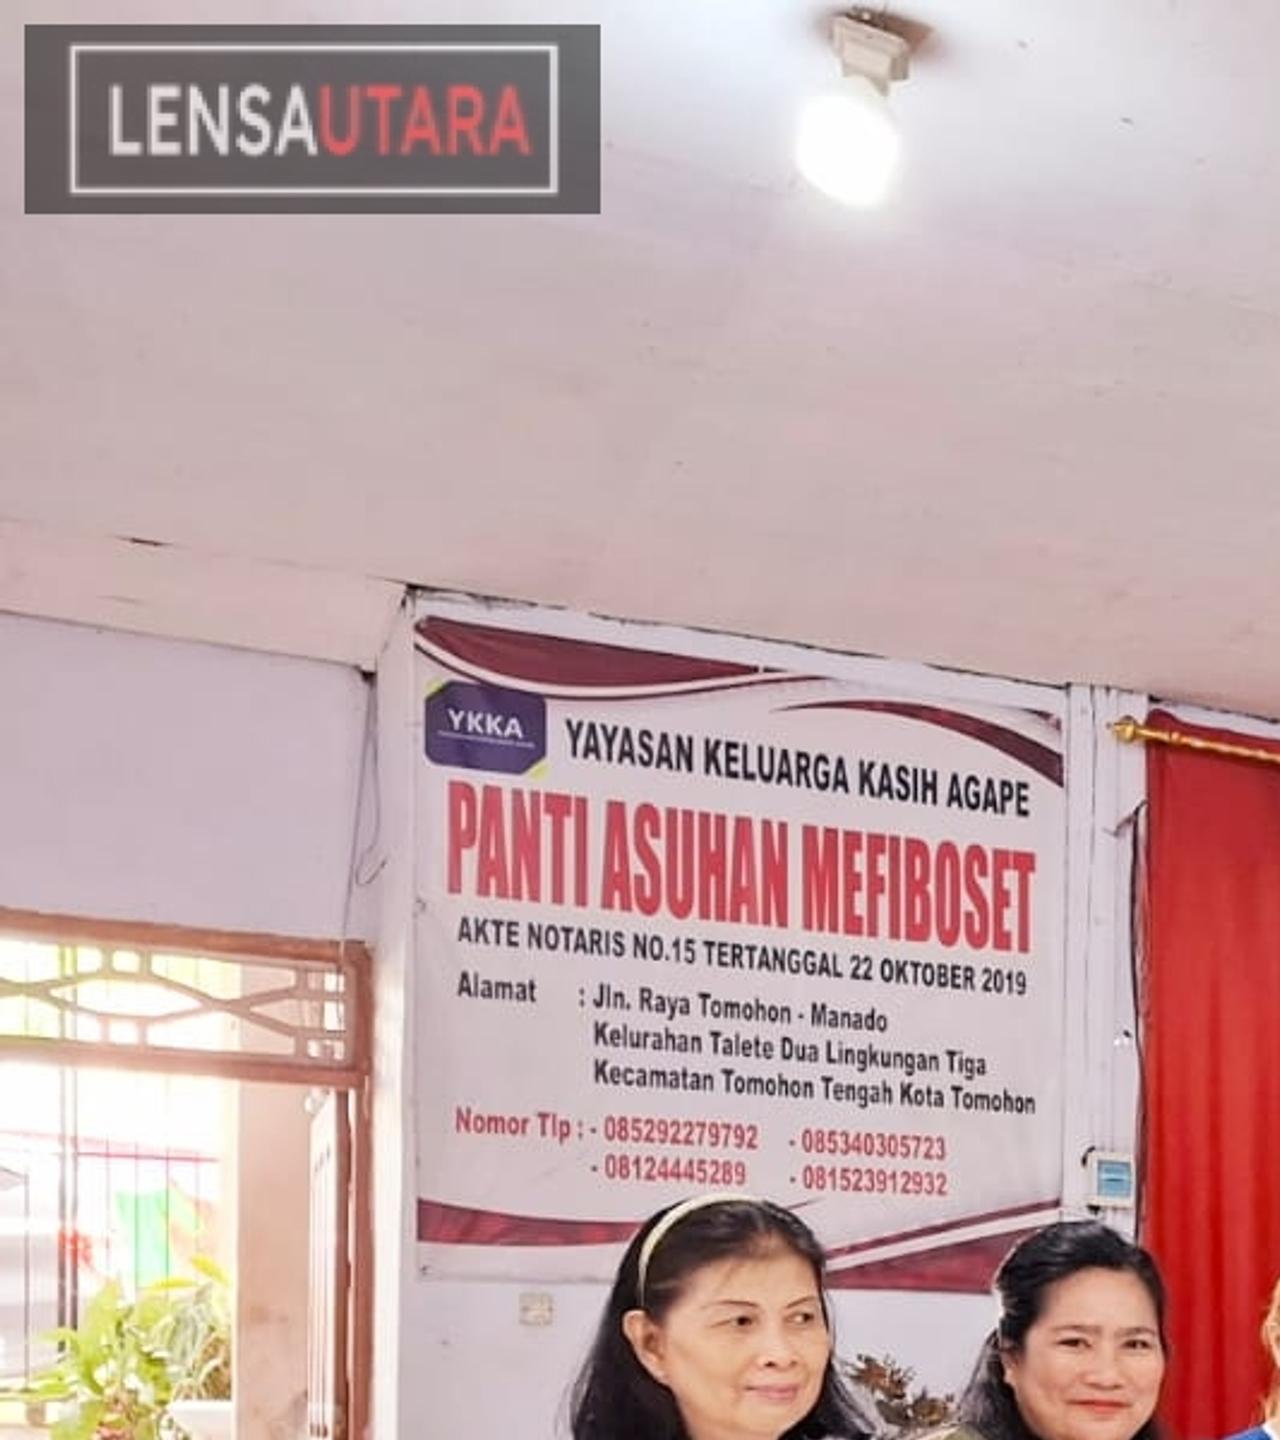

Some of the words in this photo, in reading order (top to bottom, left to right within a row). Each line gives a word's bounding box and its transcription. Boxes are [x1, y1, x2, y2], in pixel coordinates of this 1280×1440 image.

[447, 708, 523, 739] YKKA
[566, 718, 693, 773] YAYASAN
[704, 737, 849, 794] KELUARGA
[859, 760, 937, 805] KASIH
[947, 773, 1030, 817] AGAPE
[447, 780, 588, 907] PANTI
[602, 800, 788, 929] ASUHAN
[802, 824, 1035, 953] MEFIBOSET
[458, 917, 519, 947] AKTE
[528, 921, 625, 957] NOTARIS
[633, 933, 695, 964] NO.15
[704, 940, 842, 978] TERTANGGAL
[850, 955, 873, 980] 22
[880, 959, 975, 990] OKTOBER
[982, 968, 1026, 995] 2019
[458, 970, 537, 1002] Alamat
[593, 984, 631, 1010] Jln.
[640, 987, 690, 1020] Raya
[698, 992, 791, 1024] Tomohon
[811, 1003, 888, 1032] Manado
[594, 1022, 702, 1053] Kelurahan
[710, 1031, 774, 1060] Talete
[781, 1036, 819, 1063] Dua
[826, 1040, 940, 1075] Lingkungan
[946, 1050, 987, 1080] Tiga
[594, 1059, 714, 1091] Kecamatan
[721, 1068, 814, 1099] Tomohon
[821, 1076, 893, 1109] Tengah
[900, 1082, 945, 1108] Kota
[951, 1085, 1036, 1115] Tomohon
[456, 1107, 530, 1137] Nomor
[537, 1112, 571, 1145] Tlp
[604, 1116, 759, 1150] 085292279792
[802, 1128, 945, 1161] 085340305723
[604, 1154, 746, 1185] 08124445289
[803, 1165, 947, 1196] 081523912932
